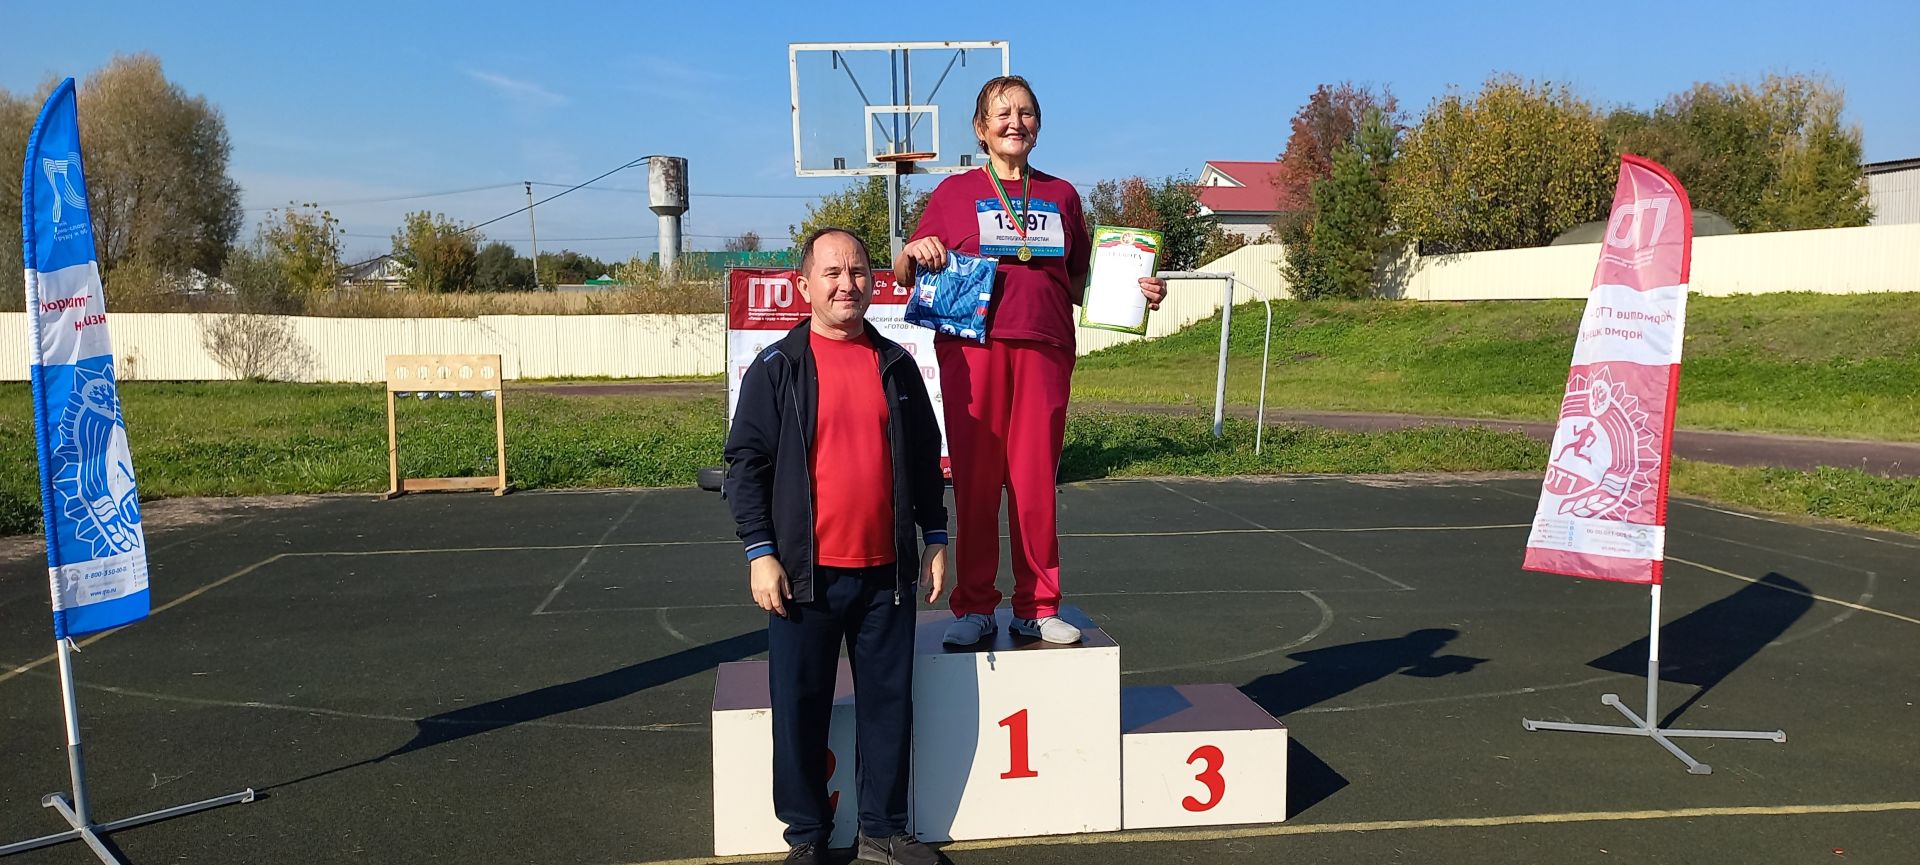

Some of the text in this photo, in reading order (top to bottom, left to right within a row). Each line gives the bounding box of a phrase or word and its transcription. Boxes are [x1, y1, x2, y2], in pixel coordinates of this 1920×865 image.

[995, 212, 1048, 231] 1397
[748, 277, 794, 308] ГТО
[998, 708, 1038, 780] 1
[1182, 744, 1226, 813] 3
